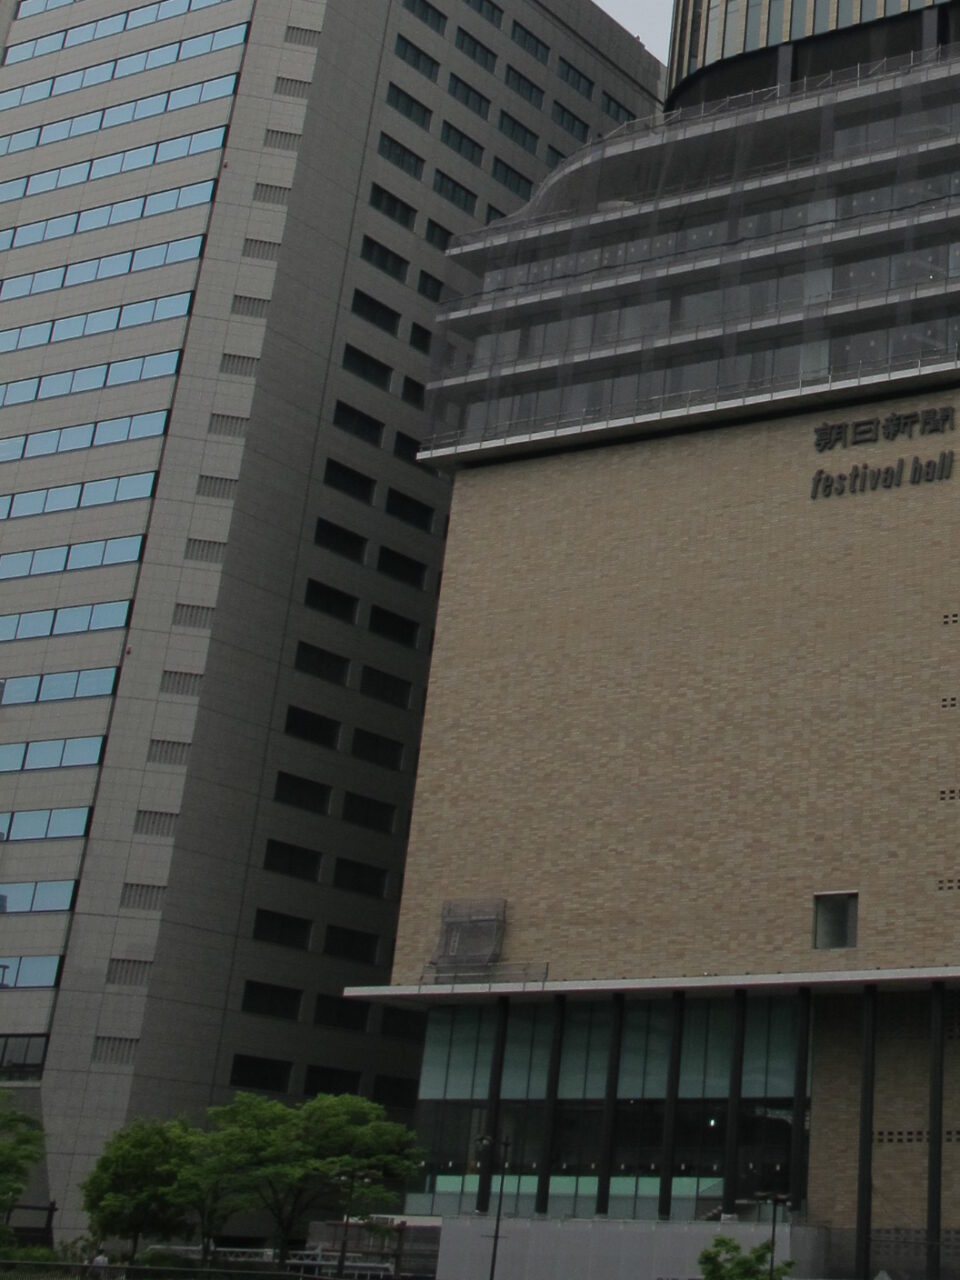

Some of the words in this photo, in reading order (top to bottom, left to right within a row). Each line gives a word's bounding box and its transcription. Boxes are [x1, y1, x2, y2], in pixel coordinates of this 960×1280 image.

[814, 406, 956, 453] 朝日新聞
[811, 457, 905, 500] festival
[910, 449, 954, 485] hall
